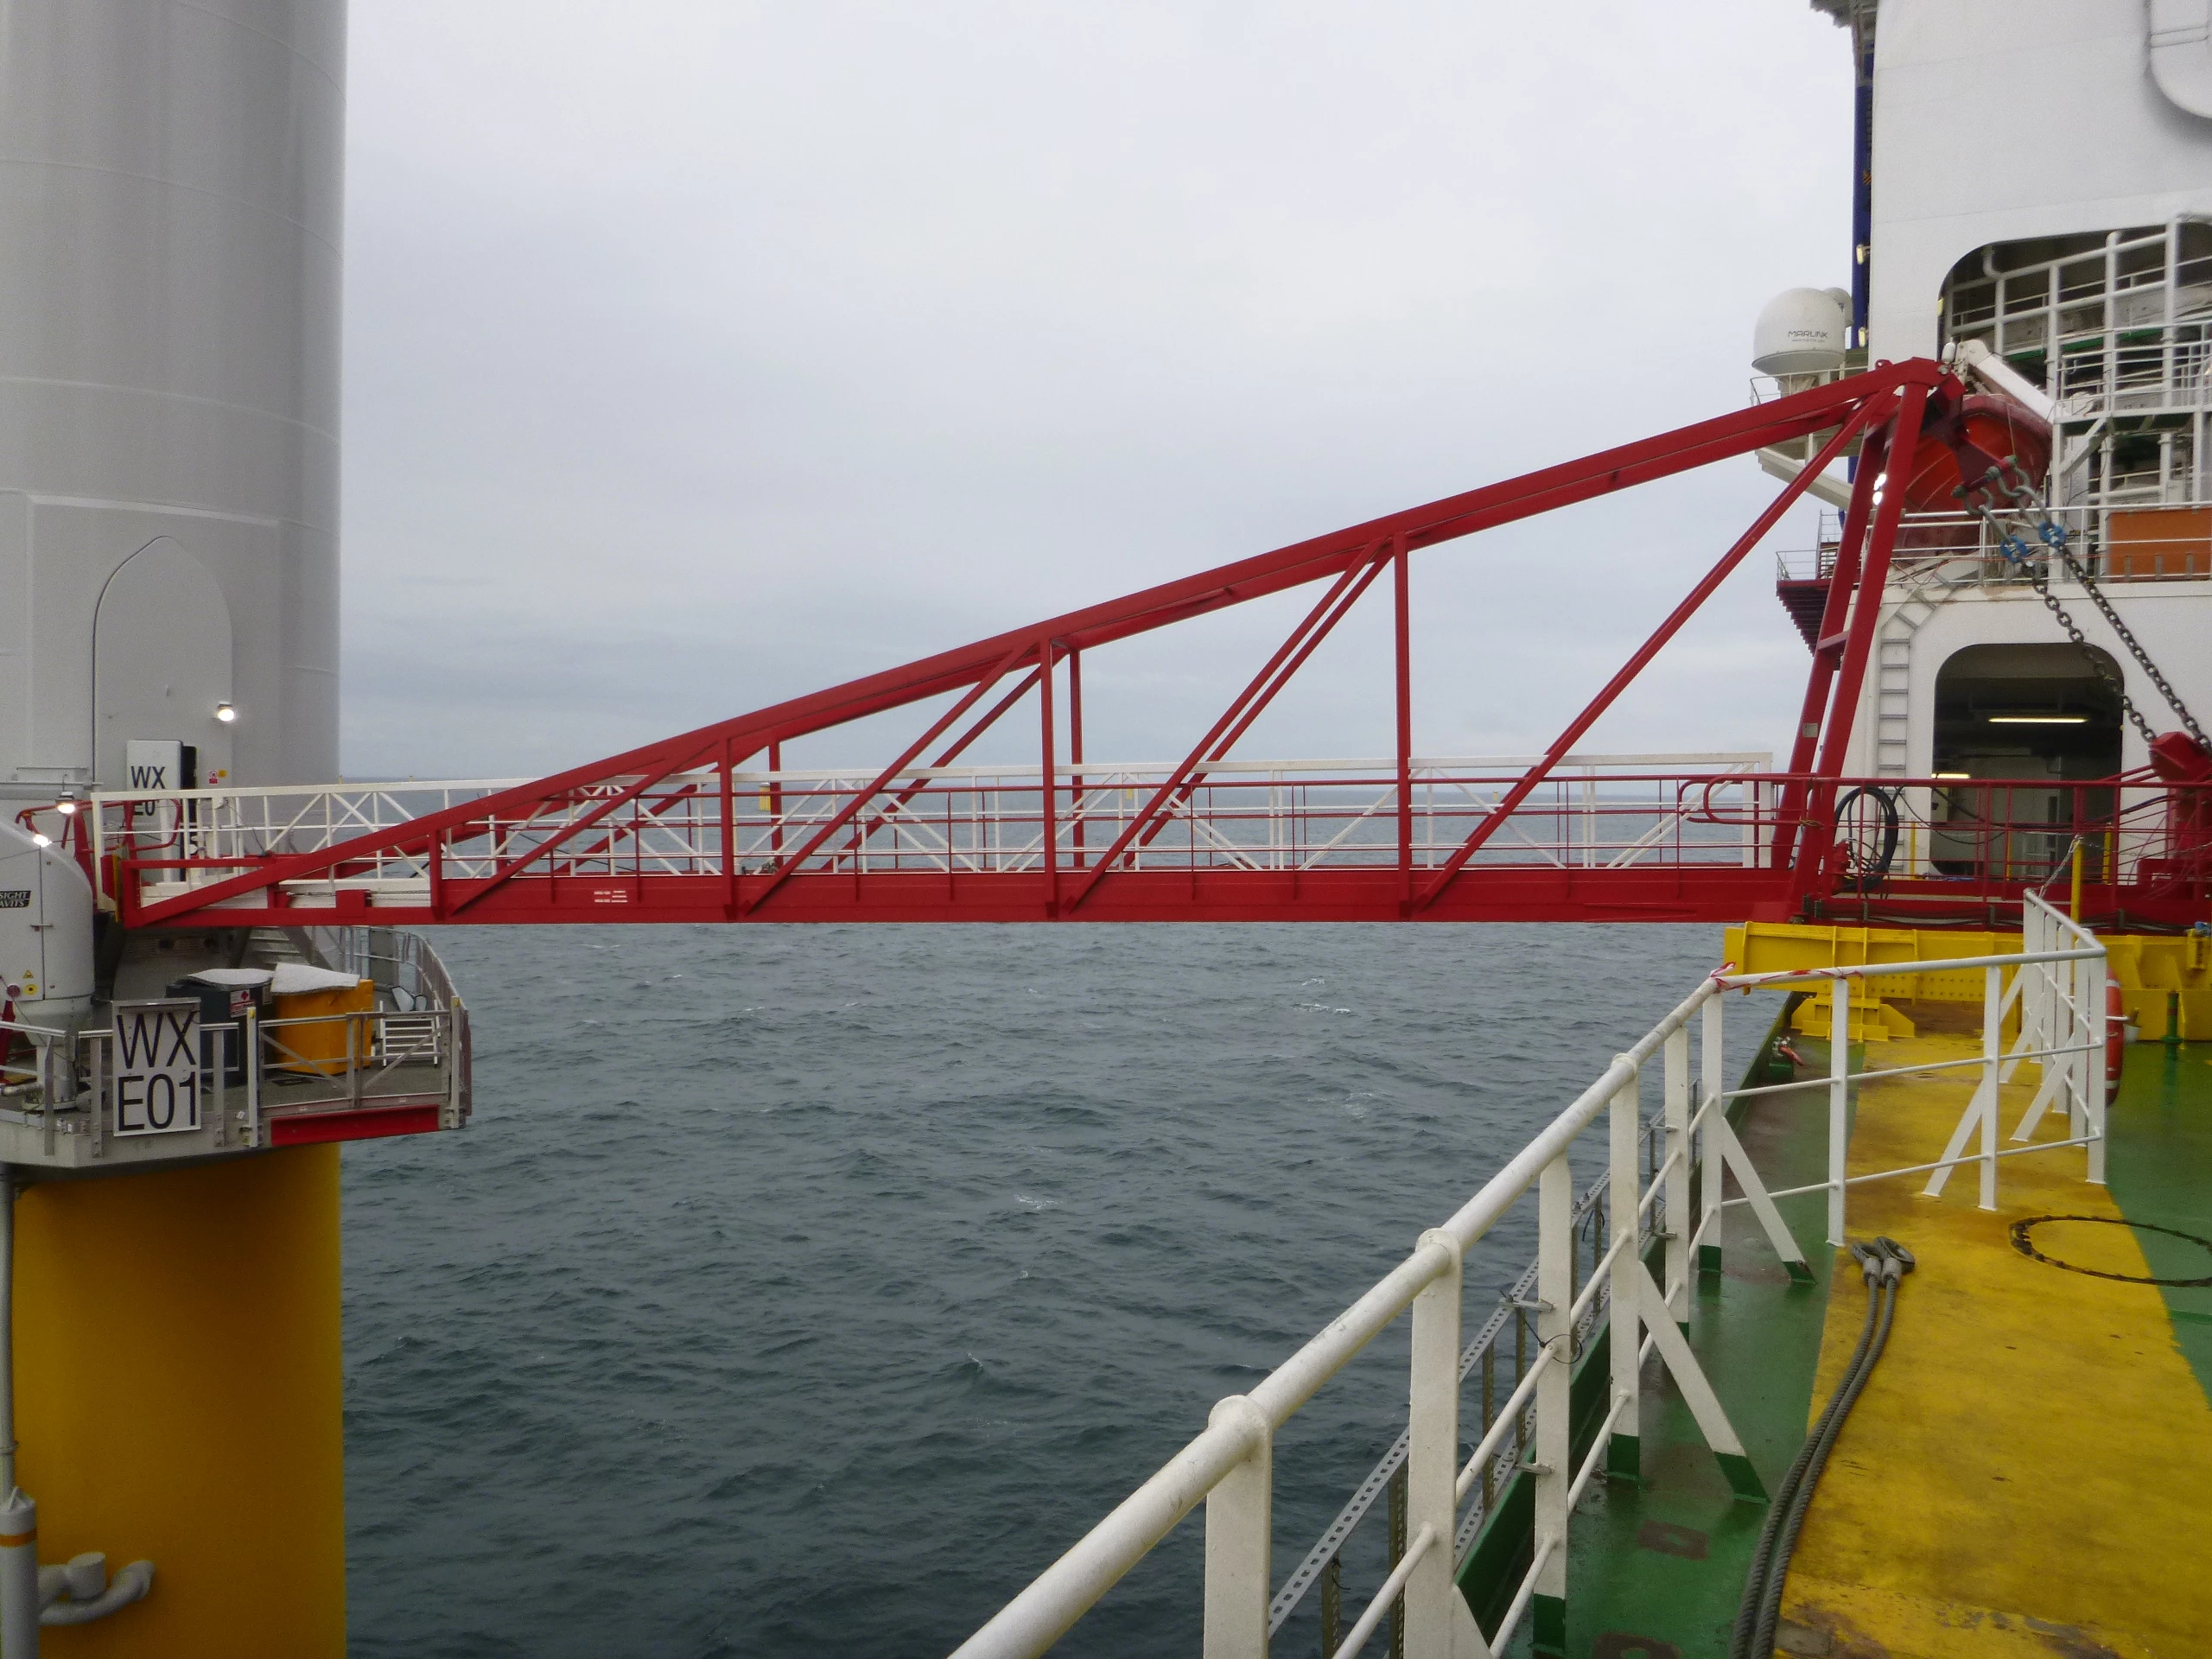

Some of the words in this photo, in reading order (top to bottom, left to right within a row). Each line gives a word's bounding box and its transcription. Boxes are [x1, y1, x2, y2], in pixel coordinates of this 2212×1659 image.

[1788, 330, 1828, 339] MARLINK
[130, 766, 166, 790] WX
[117, 1011, 196, 1070] WX
[118, 1071, 196, 1131] E01
